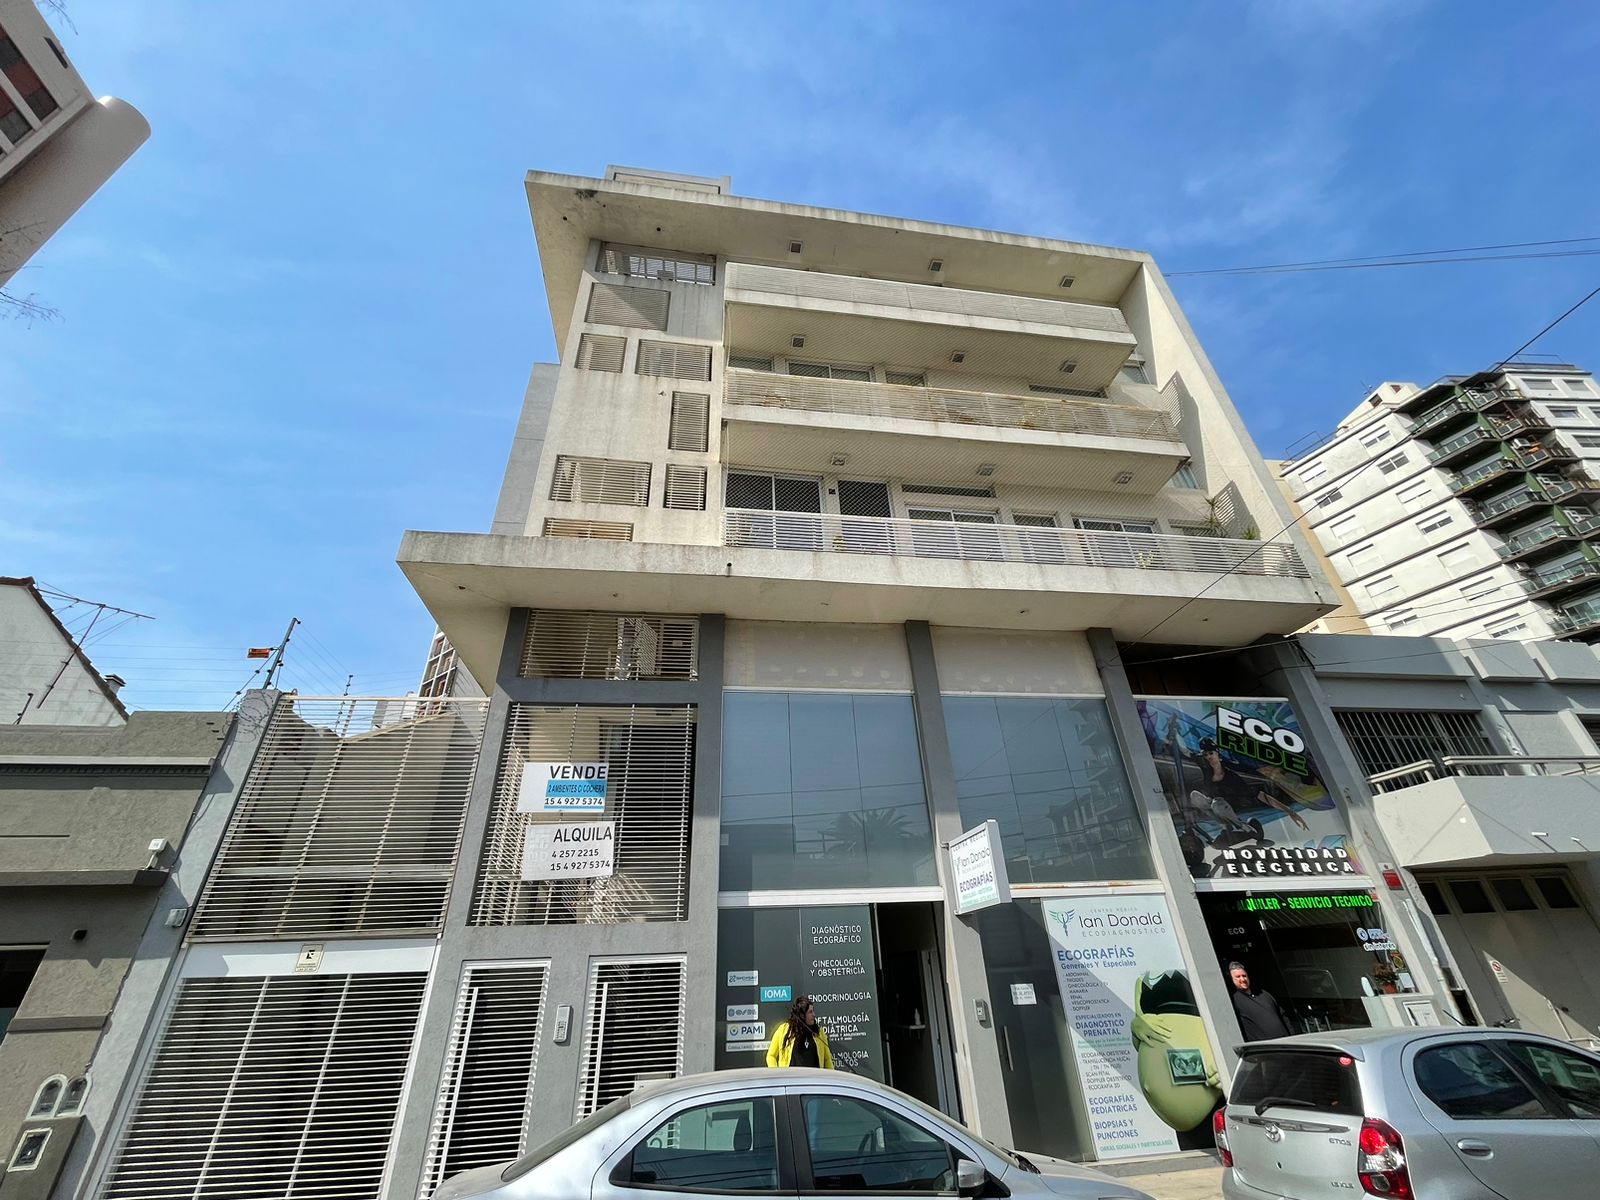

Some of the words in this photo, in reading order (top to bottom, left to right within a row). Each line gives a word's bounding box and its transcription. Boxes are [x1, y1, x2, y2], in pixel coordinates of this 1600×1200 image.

[1217, 706, 1305, 753] ECO
[1219, 727, 1309, 777] RIDE
[549, 765, 607, 779] VENDE
[545, 797, 555, 805] 15
[565, 797, 581, 805] 927
[582, 797, 603, 805] 5374
[553, 826, 612, 842] ALQUILA
[551, 851, 557, 859] 4
[559, 849, 576, 858] 257
[578, 848, 599, 857] 2215
[1222, 847, 1348, 861] MOVILIDAD
[550, 863, 561, 871] 15
[563, 862, 569, 870] 4
[571, 861, 587, 870] 927
[589, 860, 611, 869] 5374
[1227, 860, 1354, 874] ELÉCTRICA
[960, 871, 993, 893] ECOGRAFÍAS
[1287, 895, 1332, 909] SERVICIO
[1331, 894, 1374, 907] TECNICO
[1079, 915, 1104, 929] Ian
[1107, 911, 1163, 927] Donald
[811, 924, 862, 935] DIAGNÓSTICO
[1082, 927, 1167, 938] ECODIAGNOSTICO
[1227, 926, 1246, 935] ECO
[813, 934, 862, 945] ECOGRÁFICO
[1057, 945, 1135, 961] ECOGRAFÍAS
[812, 958, 862, 968] GINECOLOGIA
[1061, 961, 1094, 970] Generales
[1094, 961, 1100, 969] Y
[1103, 959, 1137, 968] Especiales
[810, 969, 815, 977] Y
[817, 966, 866, 977] OBSTETRICIA
[764, 989, 788, 999] IOMA
[808, 991, 872, 1002] ENDOCRINOLOGIA
[822, 1024, 859, 1034] DIÁTRICA
[1075, 1019, 1125, 1030] DIAGNOSTICO
[741, 1026, 763, 1035] PAMI
[1083, 1028, 1122, 1037] PRENATAL
[1089, 1094, 1135, 1105] ECOGRAFÍAS
[1091, 1104, 1138, 1114] PEDIATRICAS
[1094, 1120, 1128, 1130] BIOPSIAS
[1128, 1118, 1134, 1126] Y
[1097, 1129, 1139, 1140] PUNCIONES
